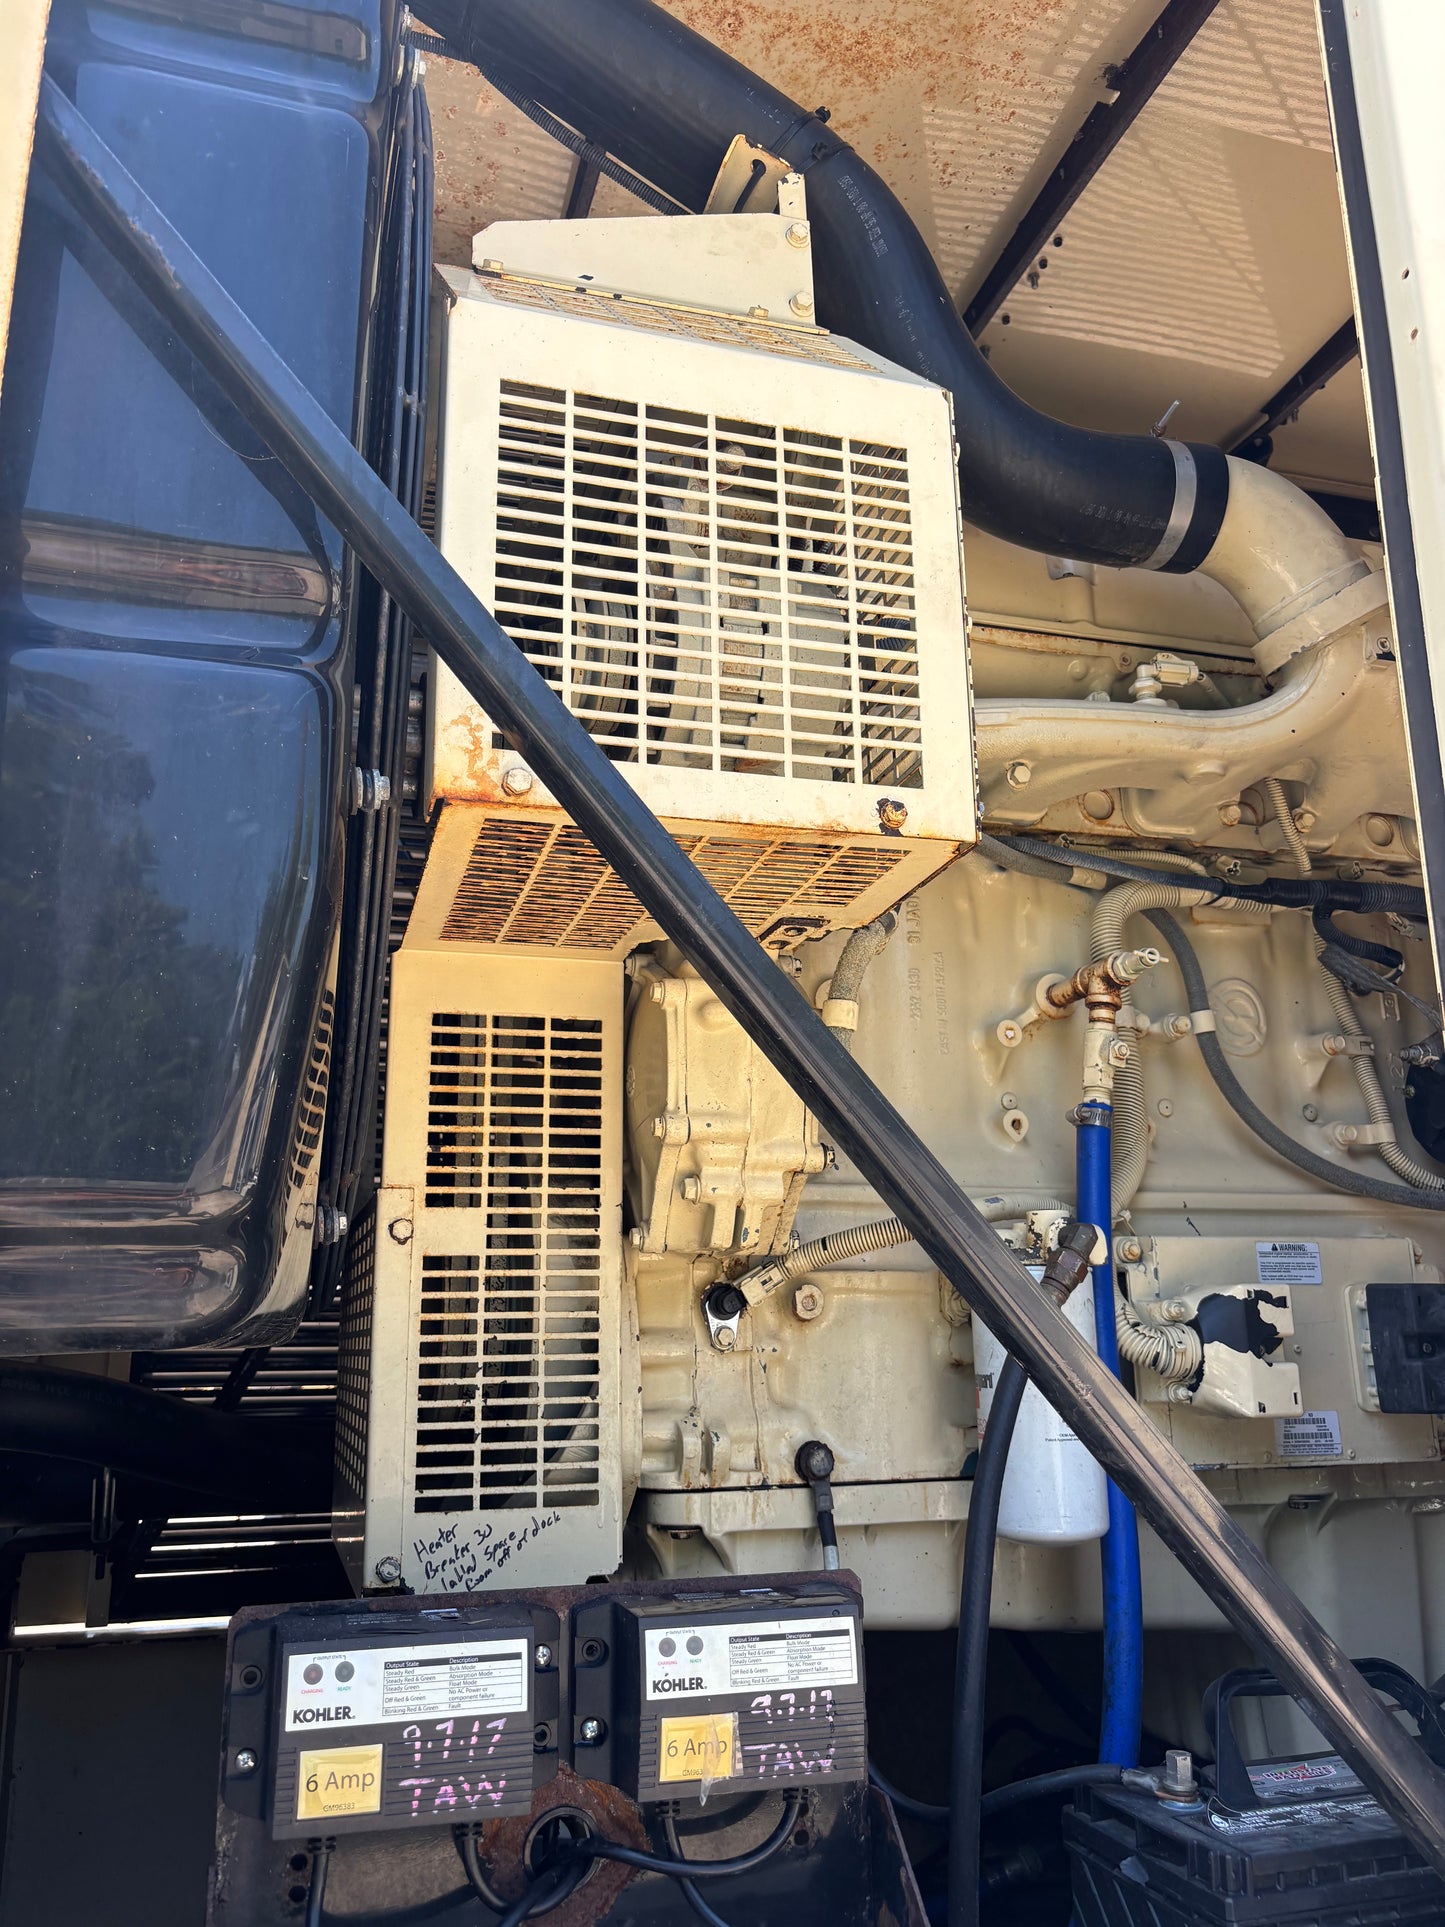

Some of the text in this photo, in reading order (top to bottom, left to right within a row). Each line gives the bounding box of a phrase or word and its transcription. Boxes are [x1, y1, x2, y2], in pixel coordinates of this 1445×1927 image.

[532, 1510, 561, 1538] dock
[413, 1523, 459, 1563] Heater
[667, 1738, 728, 1758] 6 Amp
[306, 1771, 375, 1792] 6 Amp
